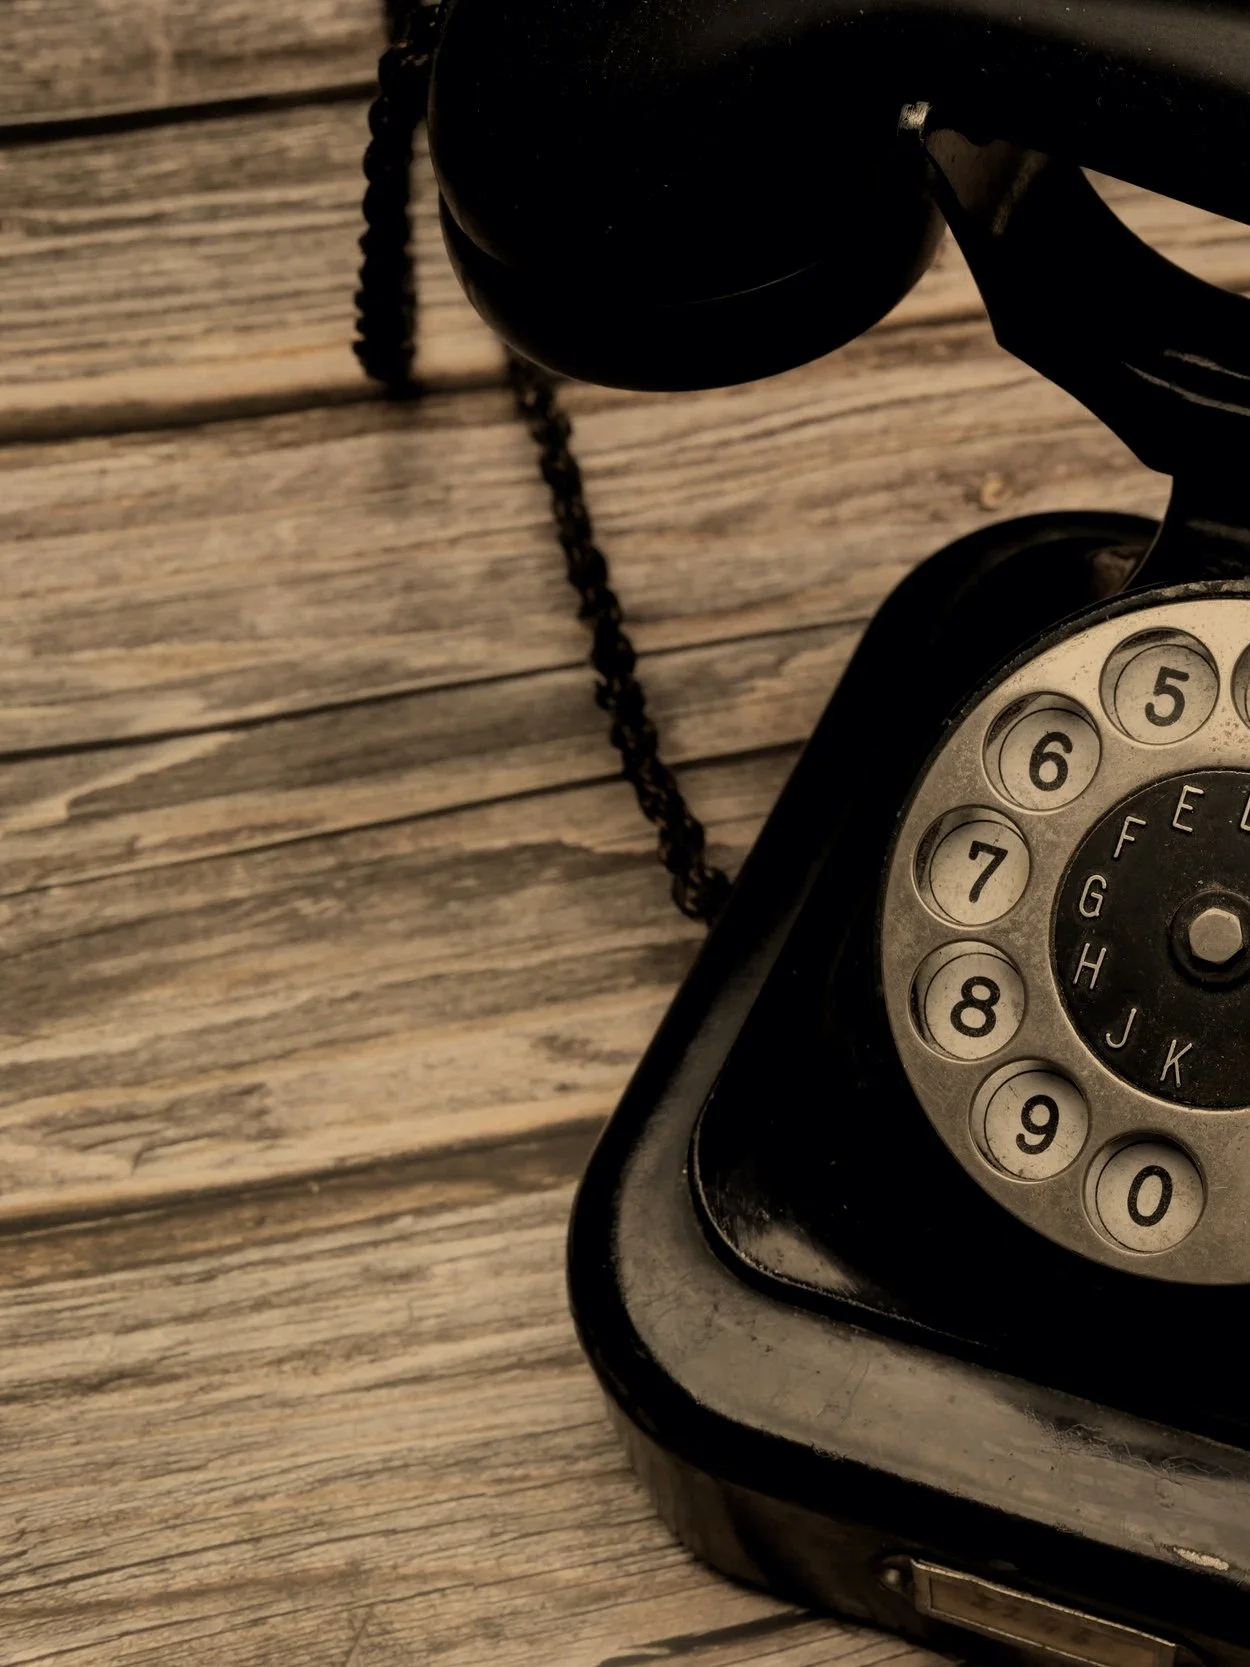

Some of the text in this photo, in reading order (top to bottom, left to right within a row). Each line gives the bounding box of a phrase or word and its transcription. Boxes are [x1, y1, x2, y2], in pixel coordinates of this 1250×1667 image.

[1145, 666, 1189, 726] 5
[1029, 731, 1073, 791] 6
[1172, 784, 1205, 833] E
[1113, 815, 1147, 858] F
[969, 840, 1008, 903] 7
[1078, 874, 1107, 918] G
[1073, 942, 1107, 990] H
[950, 976, 1000, 1037] 8
[1105, 1007, 1138, 1049] J
[1159, 1038, 1193, 1086] K
[1016, 1094, 1059, 1154] 9
[1128, 1165, 1173, 1227] 0
